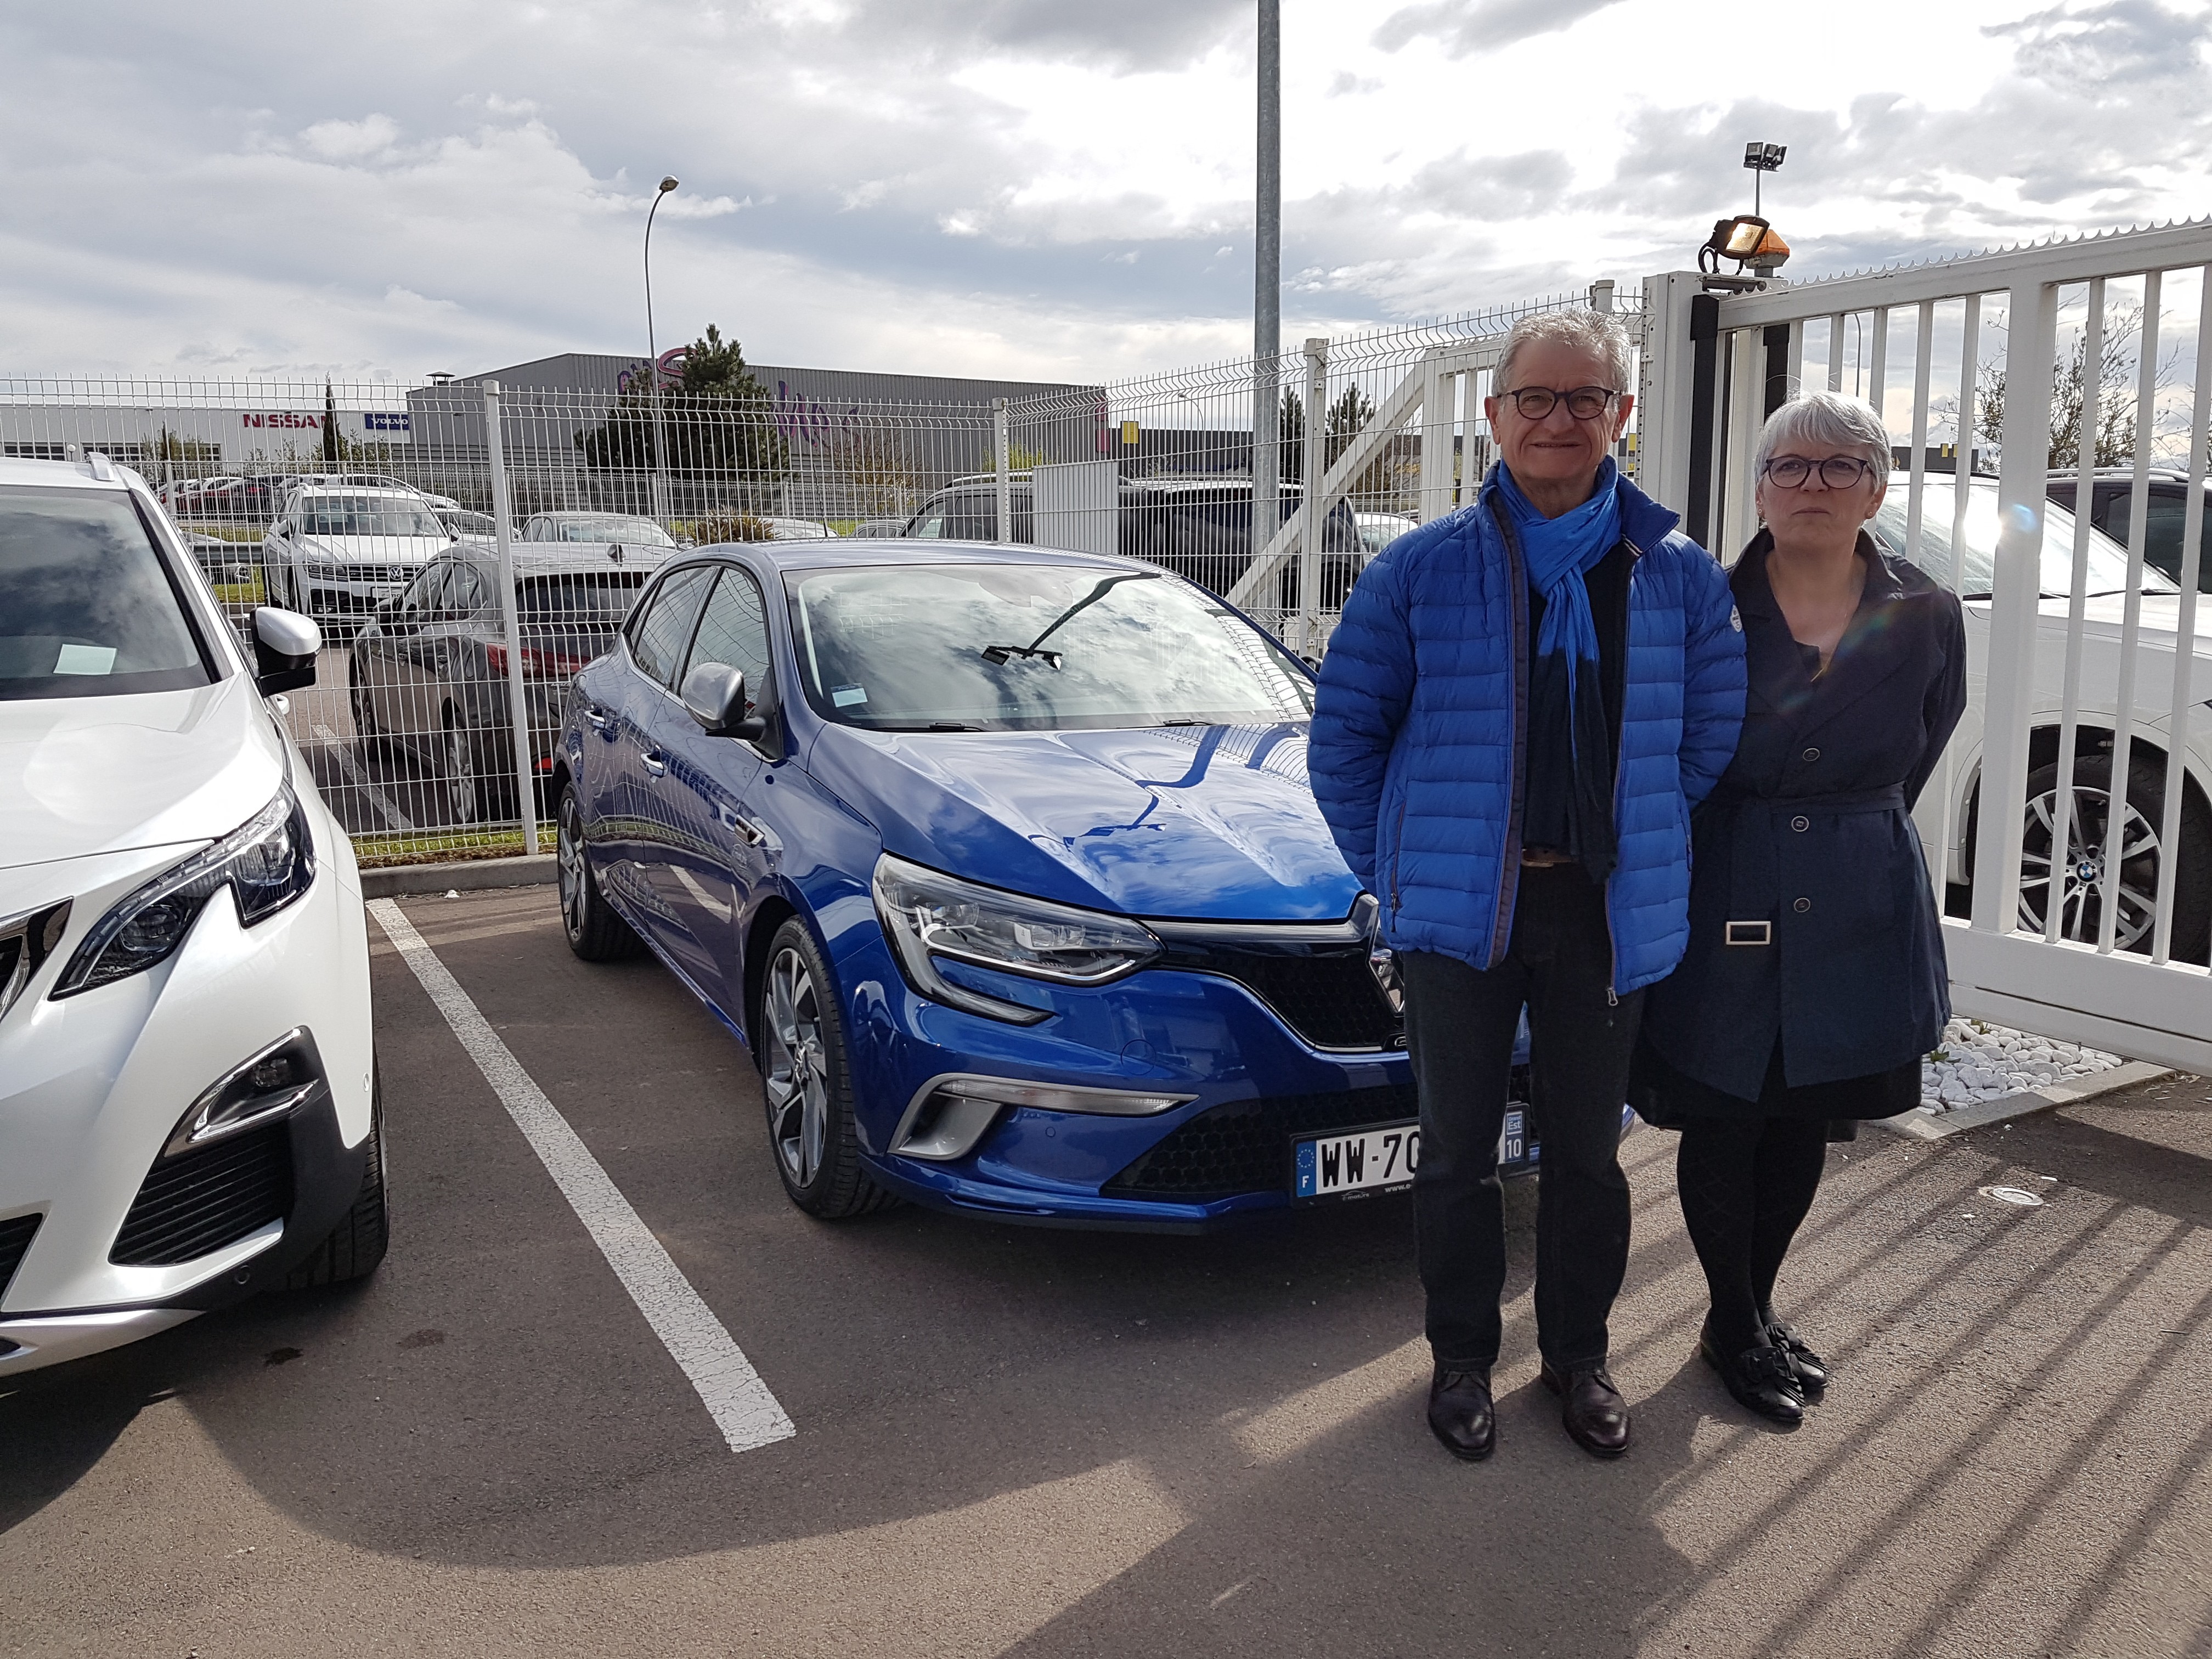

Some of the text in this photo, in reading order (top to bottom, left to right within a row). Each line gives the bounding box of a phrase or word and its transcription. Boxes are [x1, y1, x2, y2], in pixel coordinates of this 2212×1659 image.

[1508, 1120, 1521, 1130] Est
[1506, 1138, 1521, 1158] 10
[1302, 1175, 1309, 1188] F
